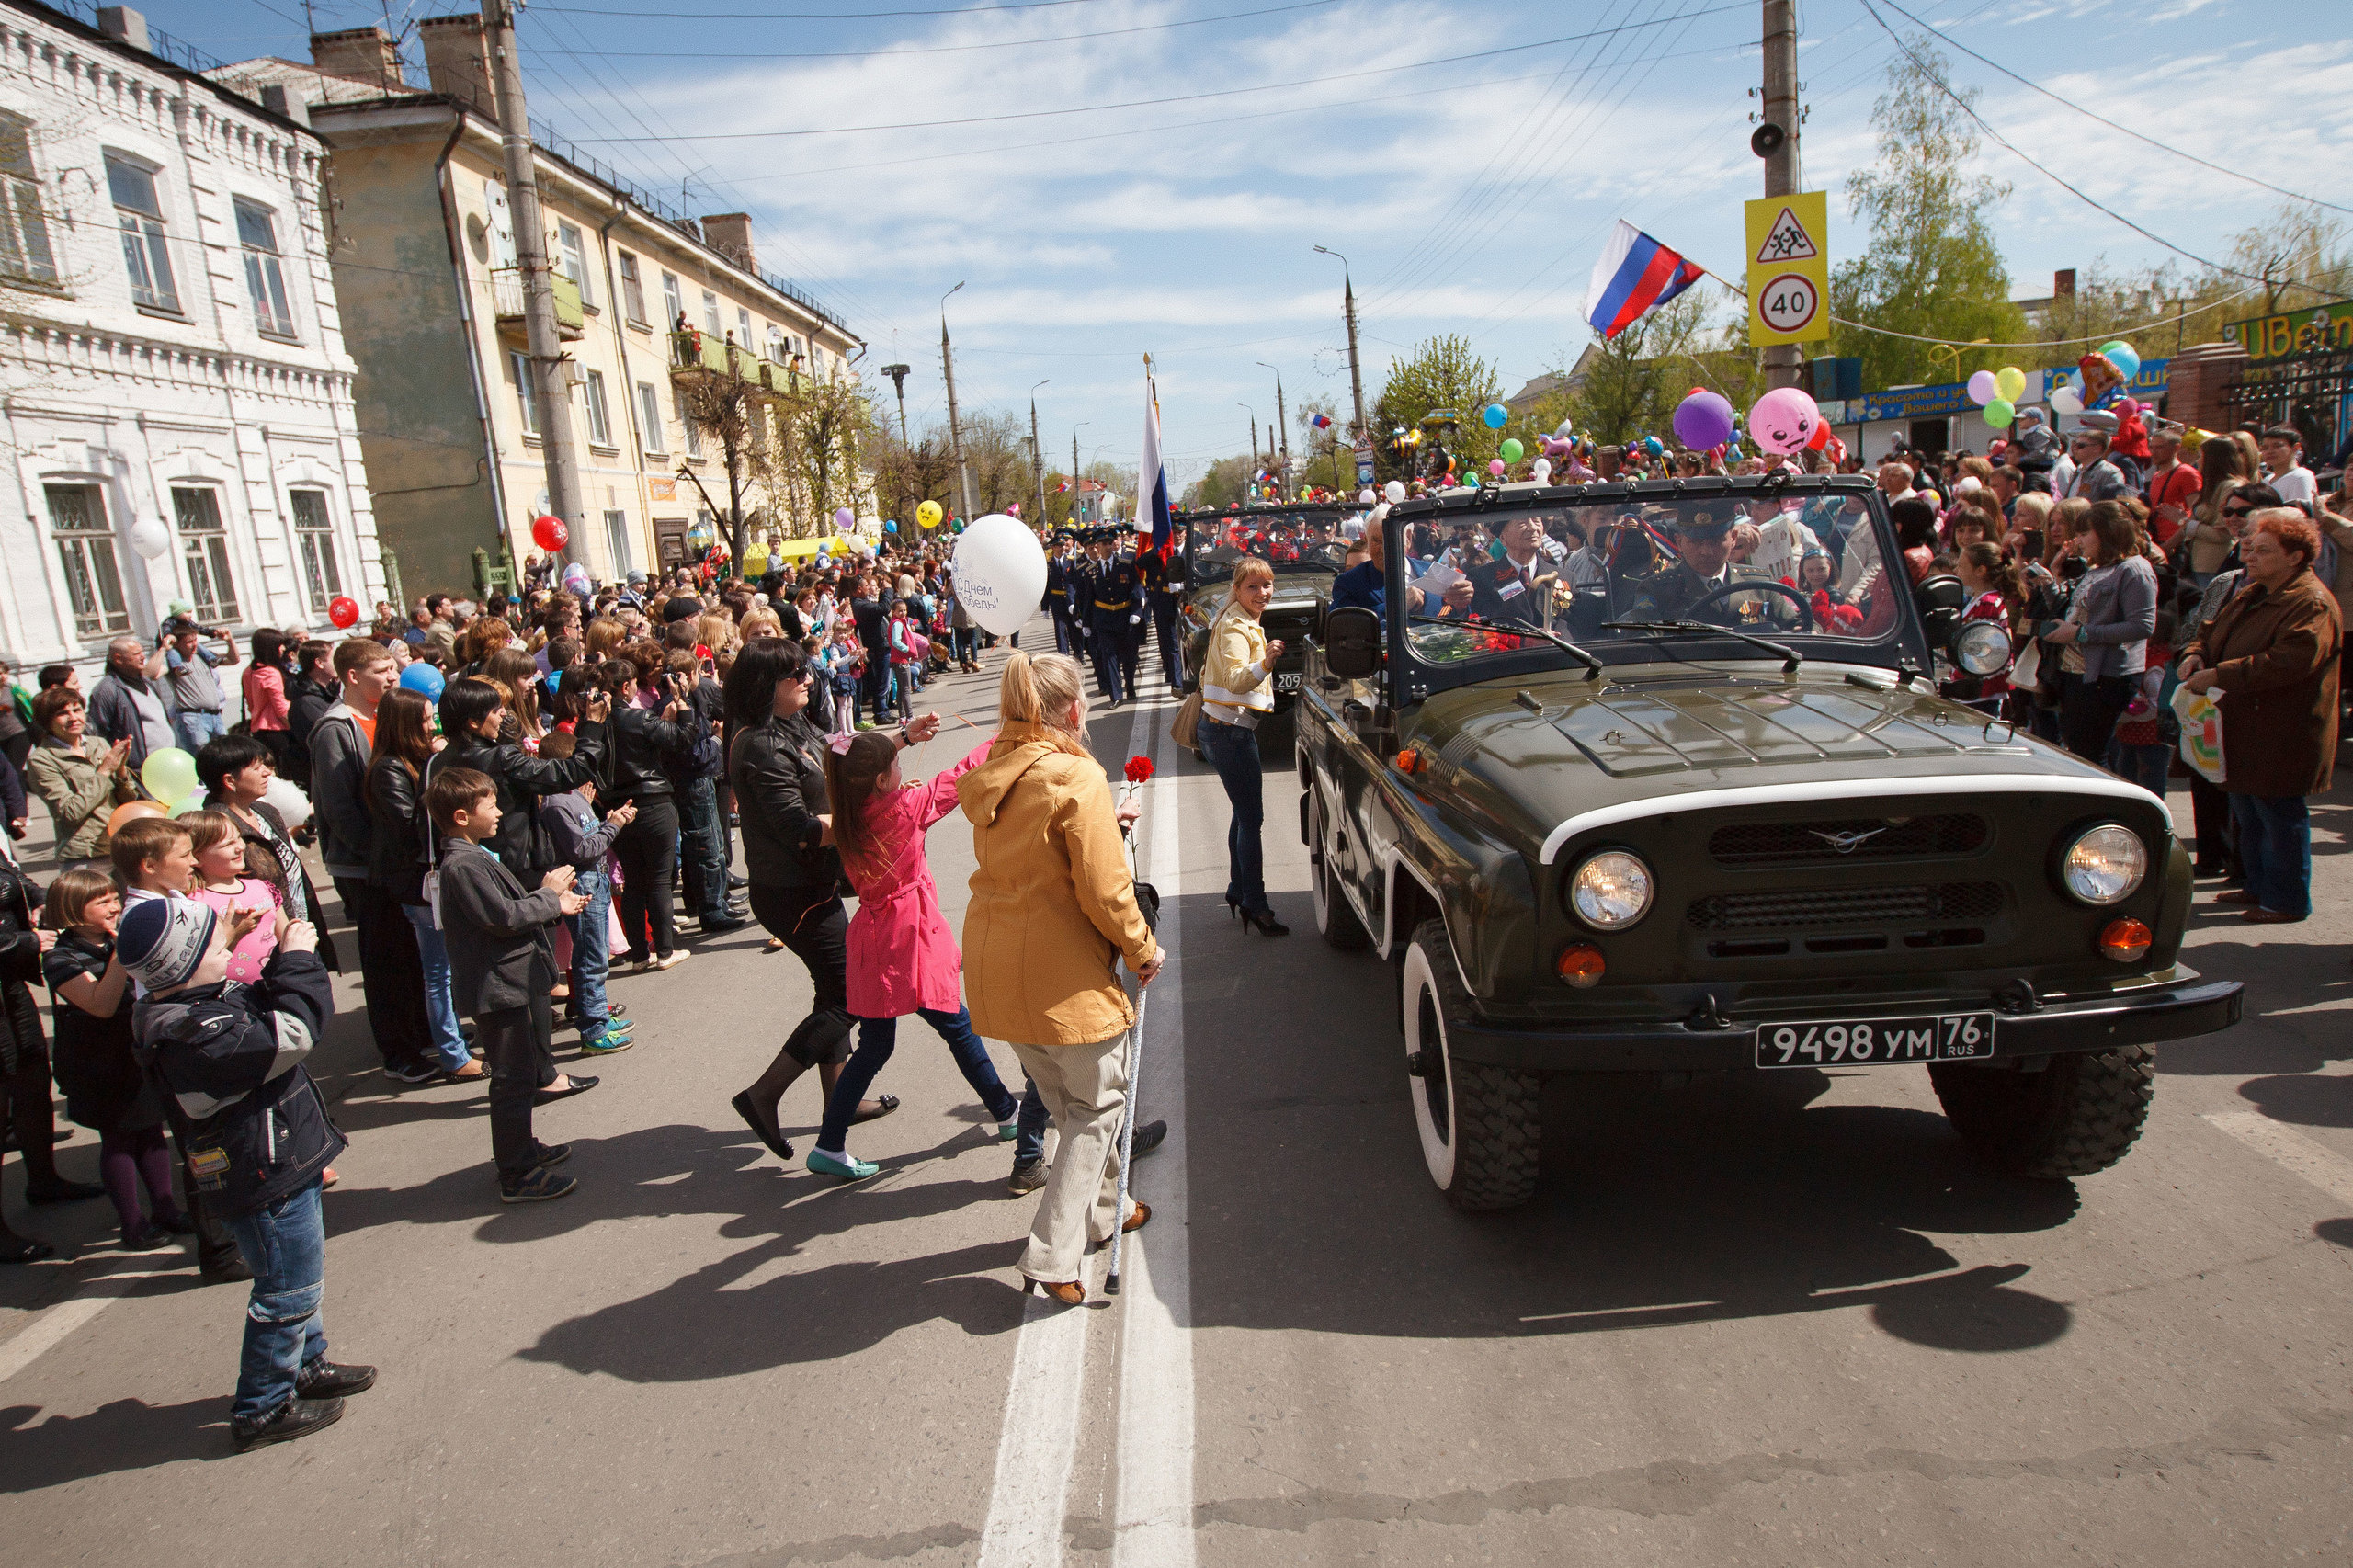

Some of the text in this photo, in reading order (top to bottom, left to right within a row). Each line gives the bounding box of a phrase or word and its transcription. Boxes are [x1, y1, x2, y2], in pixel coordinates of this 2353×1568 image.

[1770, 291, 1805, 314] 40
[1869, 392, 1935, 407] Красота
[1904, 402, 1960, 414] Вашего
[958, 577, 993, 596] С Днем
[1773, 1024, 1874, 1063] 9498
[1944, 1017, 1981, 1046] 76
[1948, 1045, 1975, 1056] RUS
